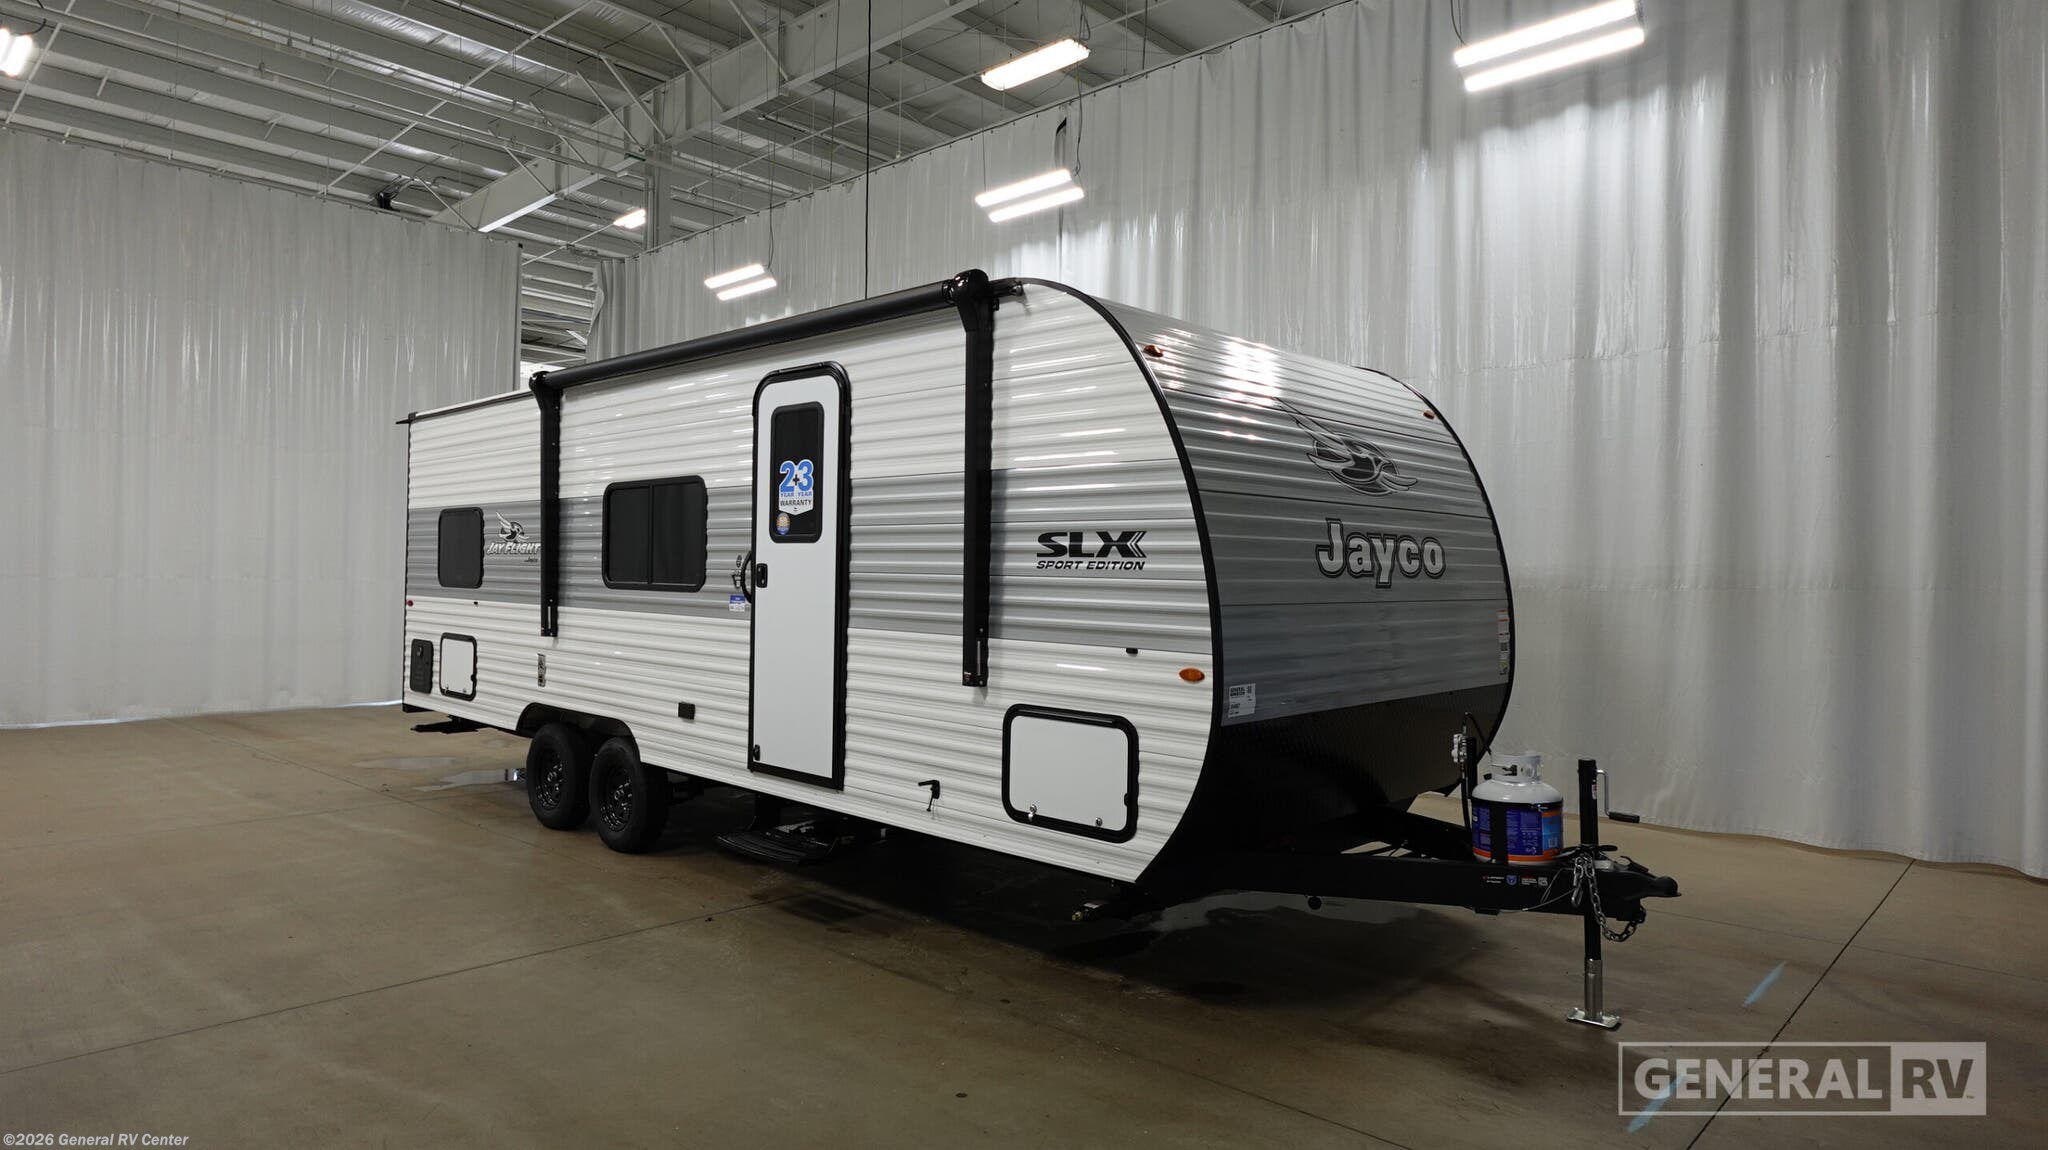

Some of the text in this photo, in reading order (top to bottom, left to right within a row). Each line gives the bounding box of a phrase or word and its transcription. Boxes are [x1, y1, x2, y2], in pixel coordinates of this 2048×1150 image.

[780, 499, 812, 507] WARRANTY
[486, 541, 541, 555] JAY FLIGHT
[1036, 531, 1147, 558] SLX
[1315, 517, 1446, 588] Jayco
[1036, 560, 1146, 571] SPORT EDITION
